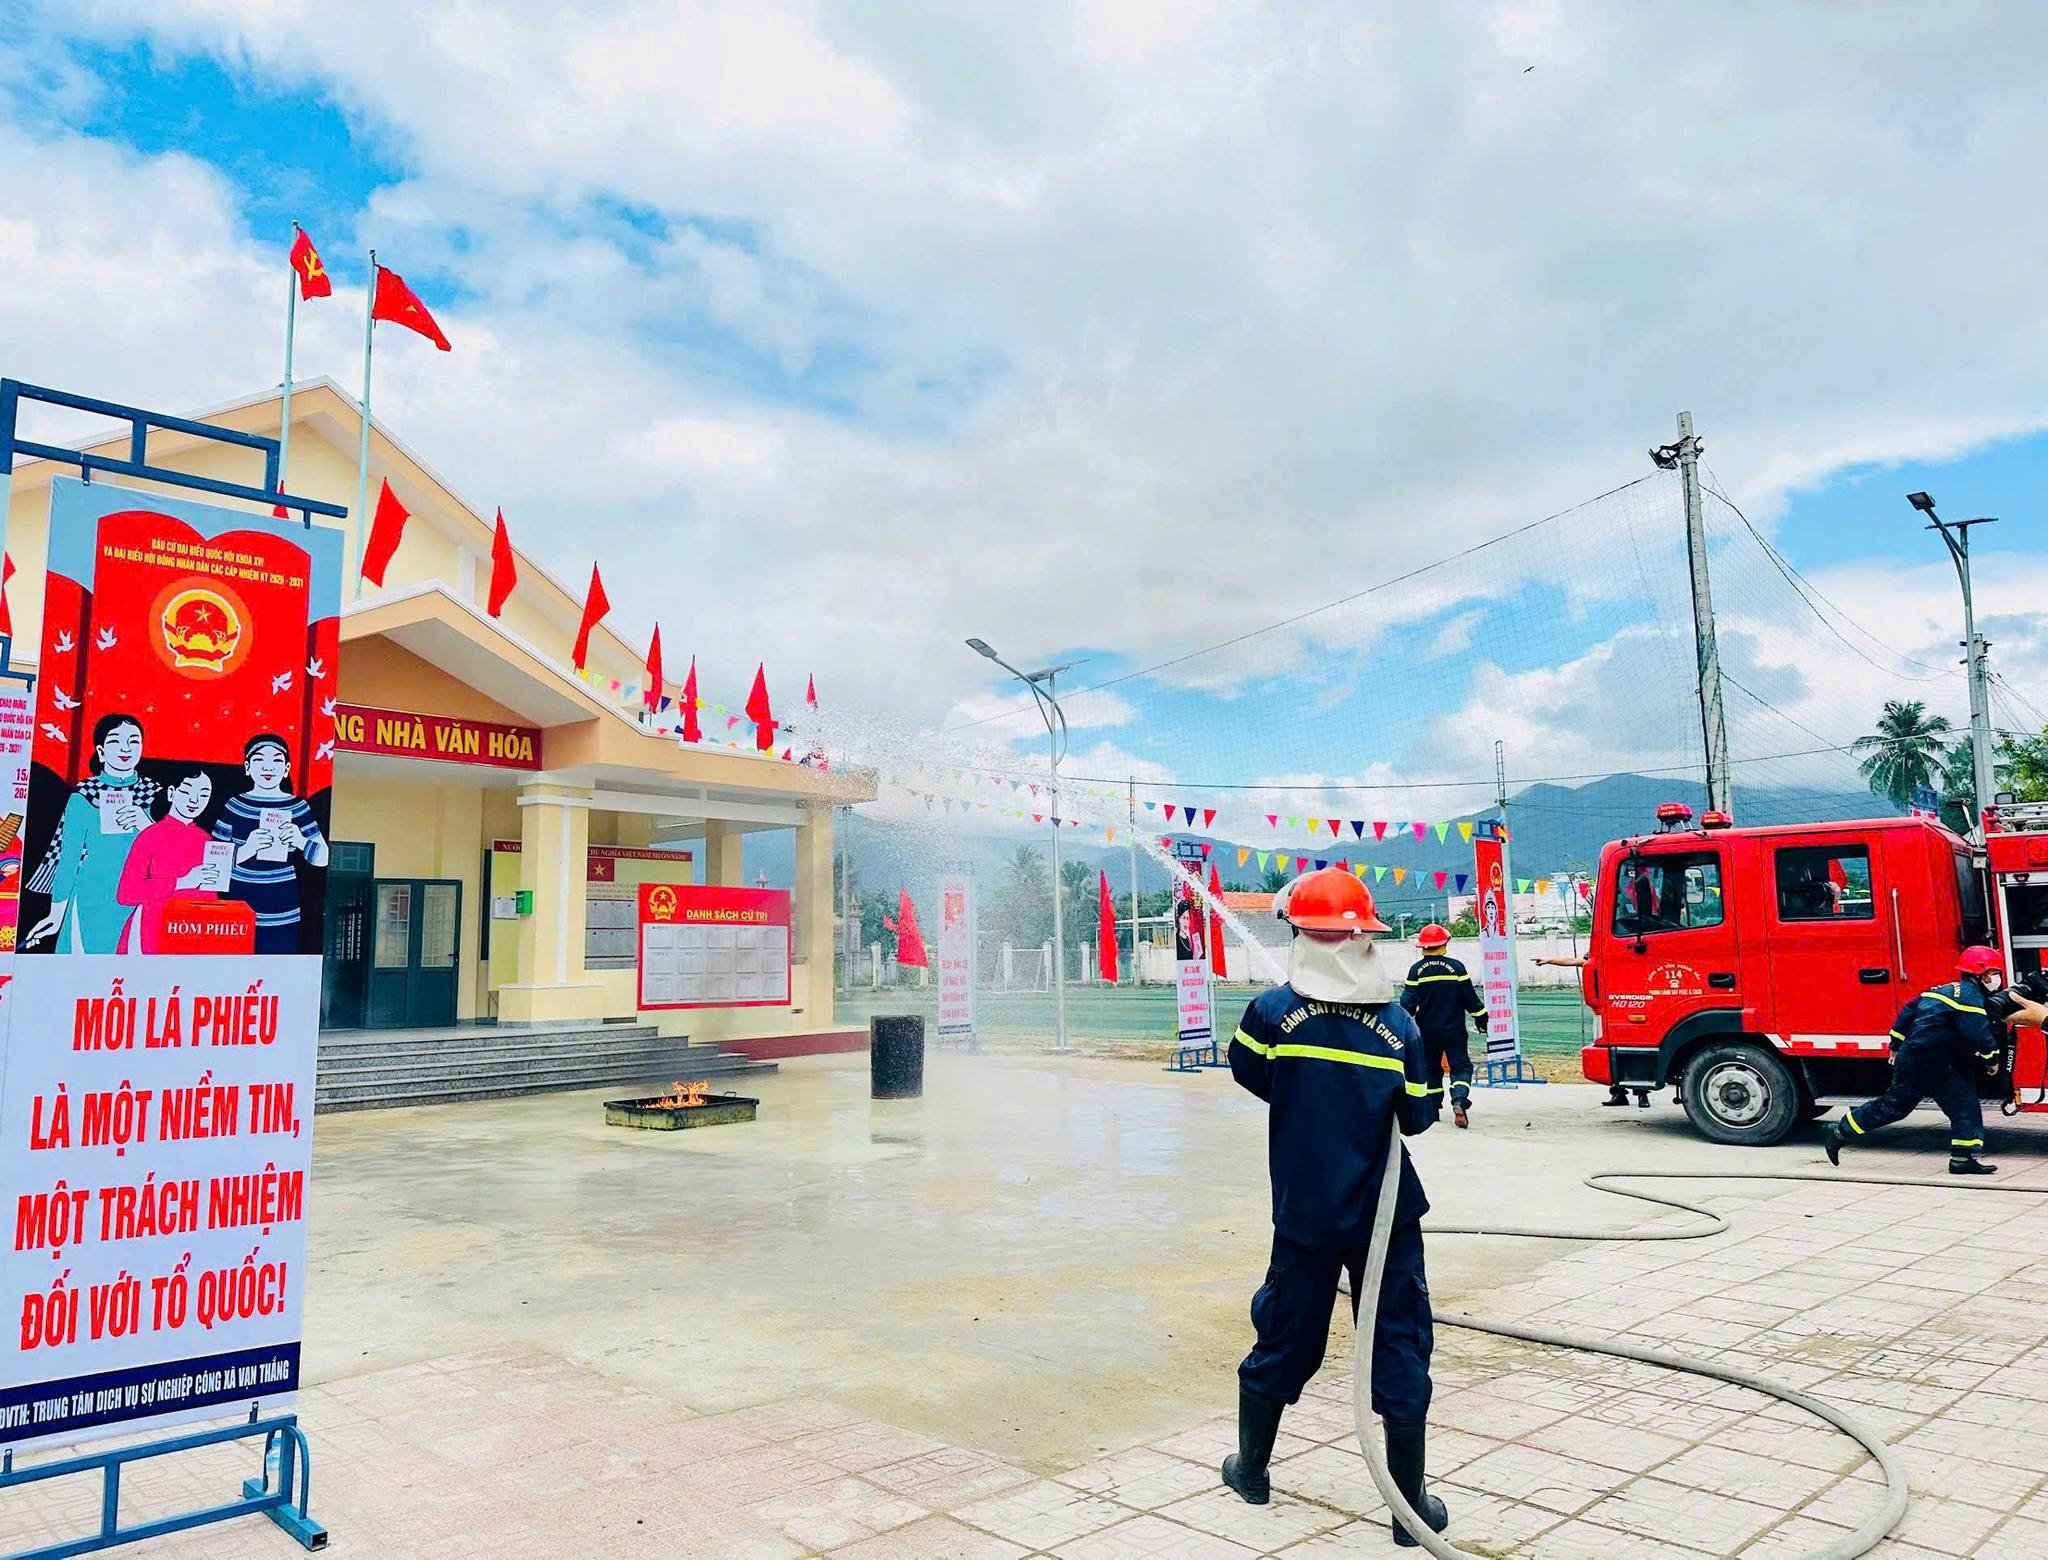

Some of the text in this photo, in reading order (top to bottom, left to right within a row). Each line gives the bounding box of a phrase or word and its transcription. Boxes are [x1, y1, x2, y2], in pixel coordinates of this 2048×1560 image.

[376, 716, 427, 750] NHÀ
[434, 722, 479, 755] VĂN
[488, 728, 534, 761] HÓA
[167, 920, 202, 935] HÒM
[714, 907, 739, 920] SÁCH
[1665, 970, 1683, 979] 114
[72, 977, 279, 1051] MỖI LÁ PHIẾU
[1375, 1022, 1404, 1051] CNCH
[2006, 1049, 2015, 1073] SONY
[30, 1069, 300, 1157] LÀ MỘT NIỀM TIN,
[15, 1162, 304, 1260] MỘT TRÁCH NHIỆM
[20, 1246, 287, 1351] ĐỐI VỚI TỔ QUỐC!
[32, 1397, 69, 1423] TRUNG
[71, 1393, 94, 1416] TÂM
[96, 1387, 122, 1415] DỊCH
[124, 1384, 139, 1410] VỤ
[141, 1379, 156, 1407] SỰ
[157, 1373, 193, 1401] NGHIỆP
[238, 1365, 257, 1390] VẠN
[259, 1356, 290, 1381] THẮNG
